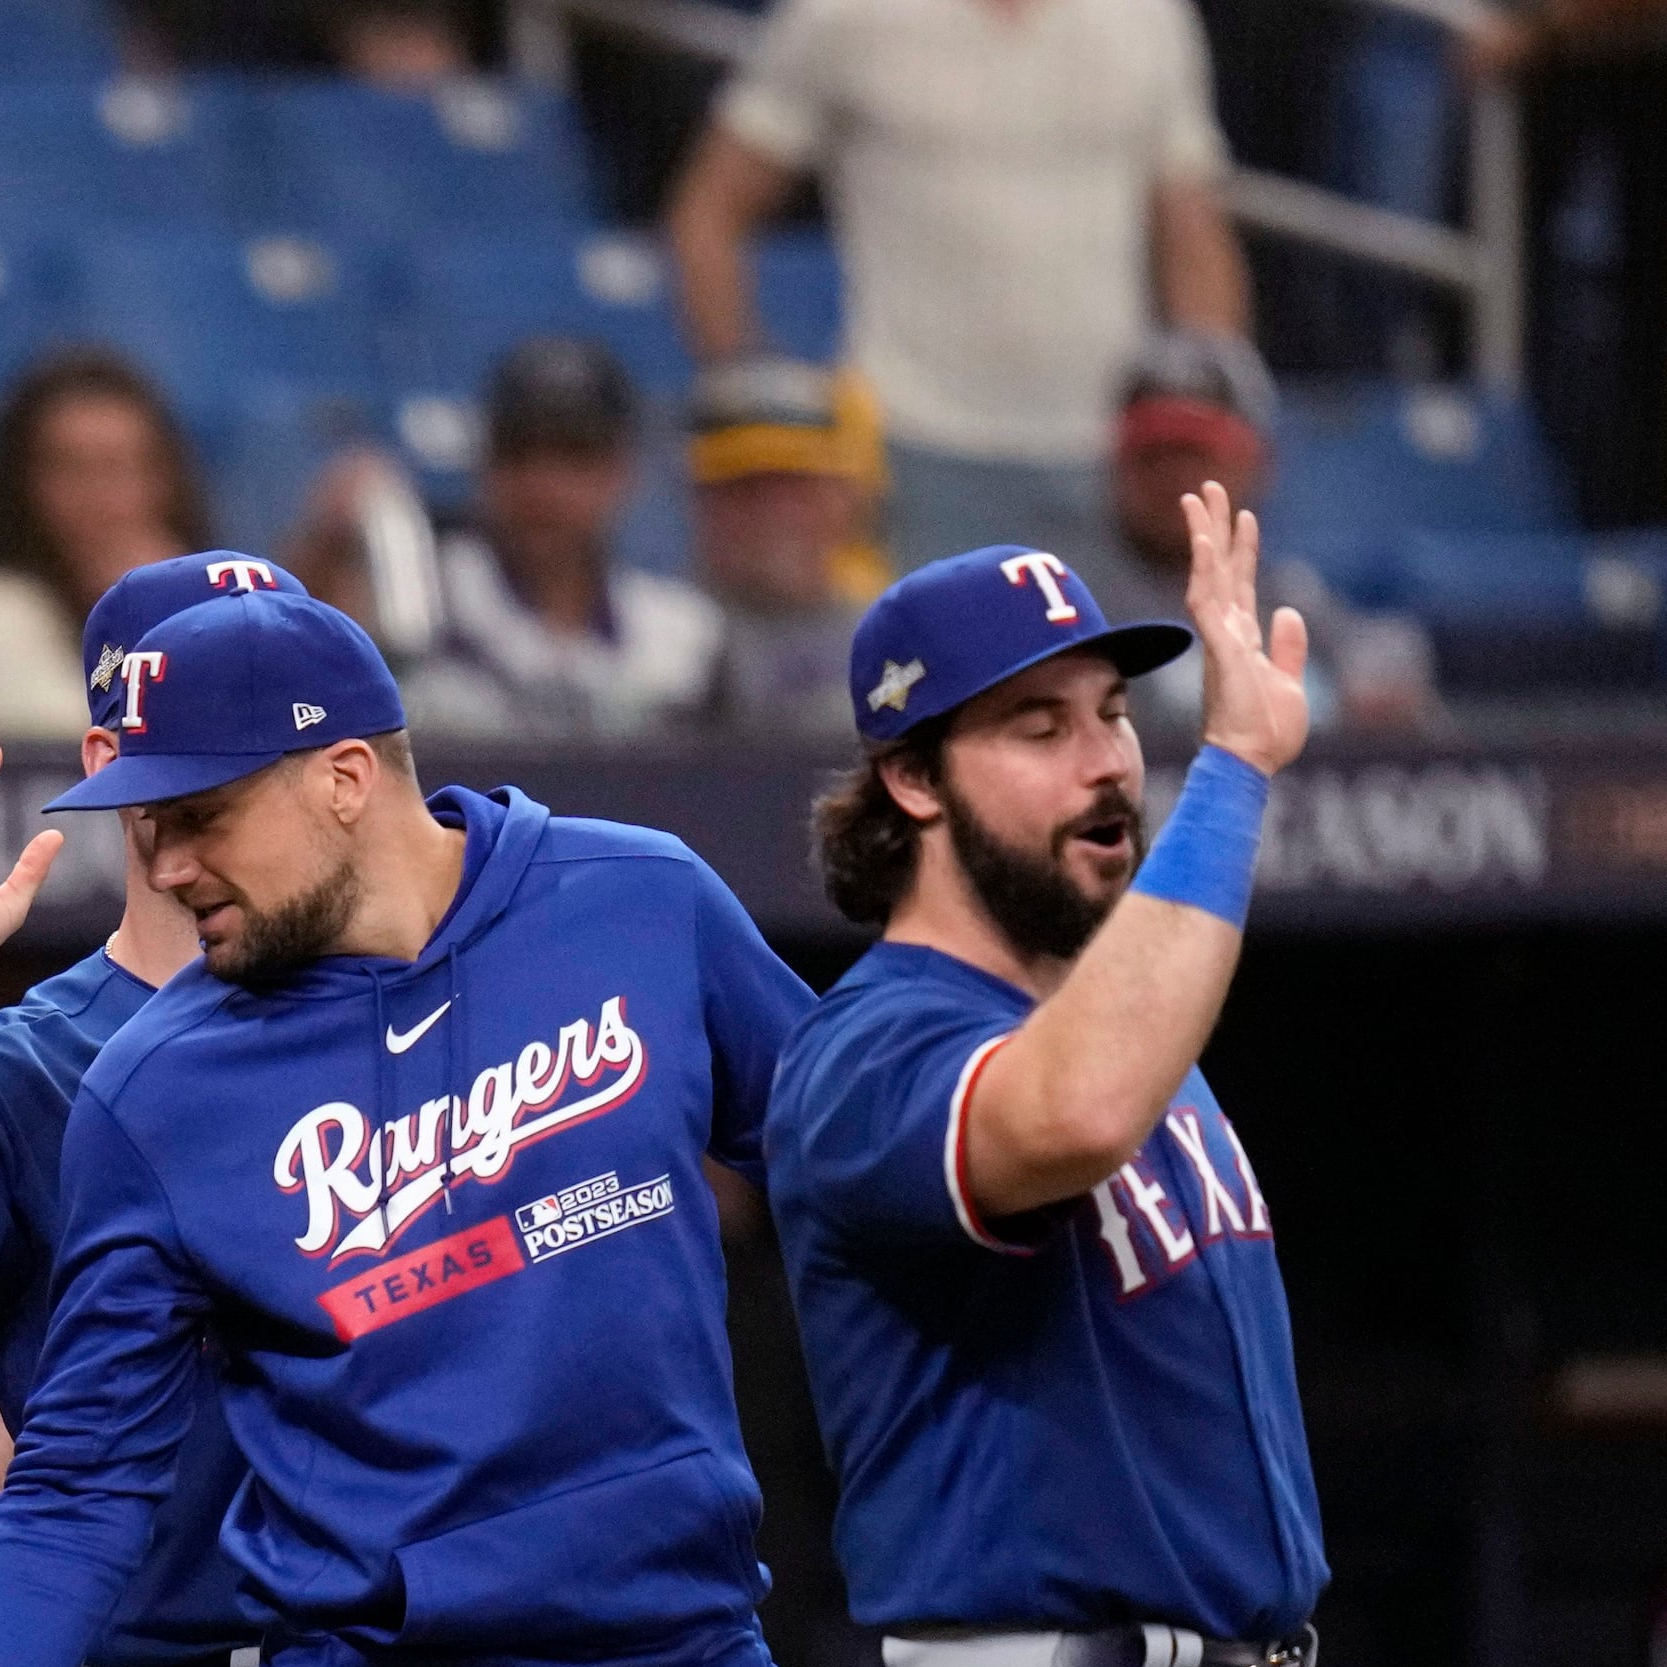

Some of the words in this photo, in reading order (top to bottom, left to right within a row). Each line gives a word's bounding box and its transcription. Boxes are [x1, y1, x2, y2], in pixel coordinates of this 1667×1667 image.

[1001, 552, 1079, 625] T
[120, 651, 167, 734] T
[273, 995, 649, 1264] Rangers
[524, 1180, 674, 1257] POSTSEASON
[559, 1175, 620, 1210] 2023
[1091, 1106, 1273, 1304] TEXA
[355, 1241, 495, 1314] TEXAS
